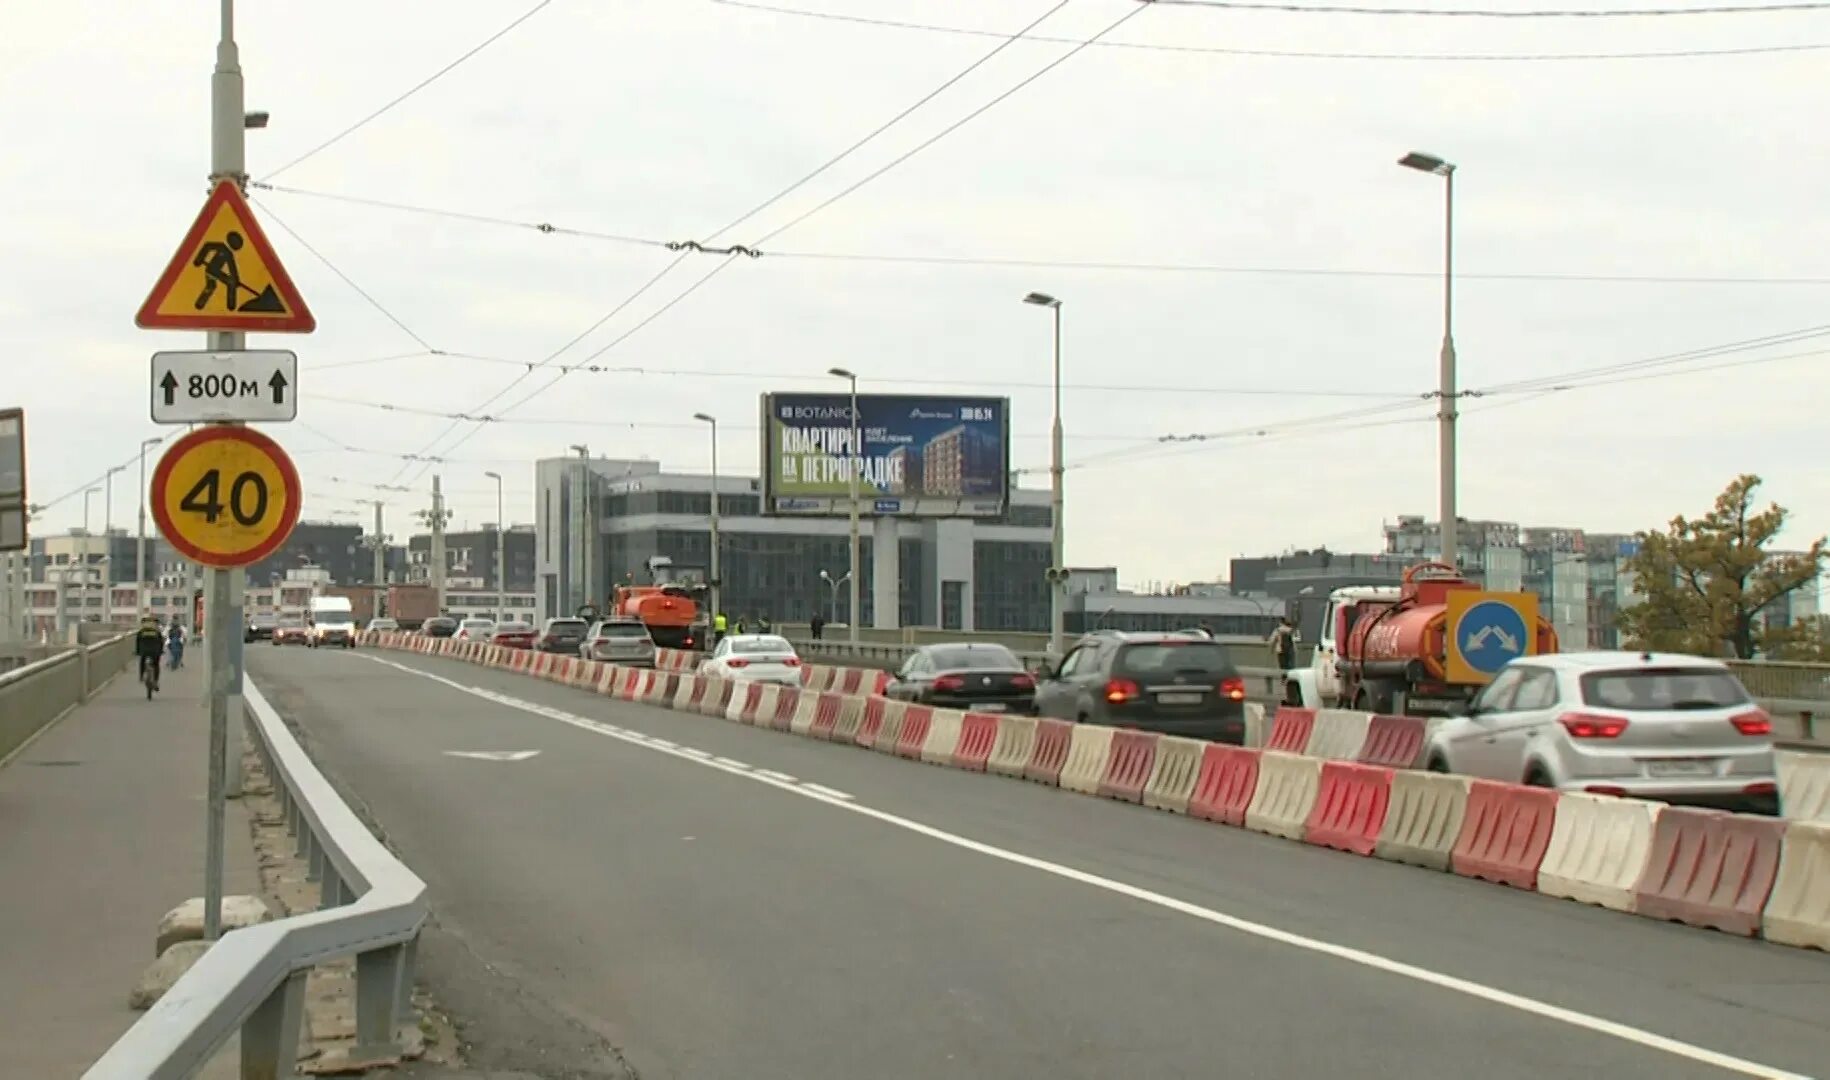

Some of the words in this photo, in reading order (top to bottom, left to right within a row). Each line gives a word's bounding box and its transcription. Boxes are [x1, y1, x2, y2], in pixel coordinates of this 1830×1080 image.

[782, 427, 862, 453] КВАРТИРЫ
[782, 455, 797, 476] НА
[180, 469, 268, 526] 40
